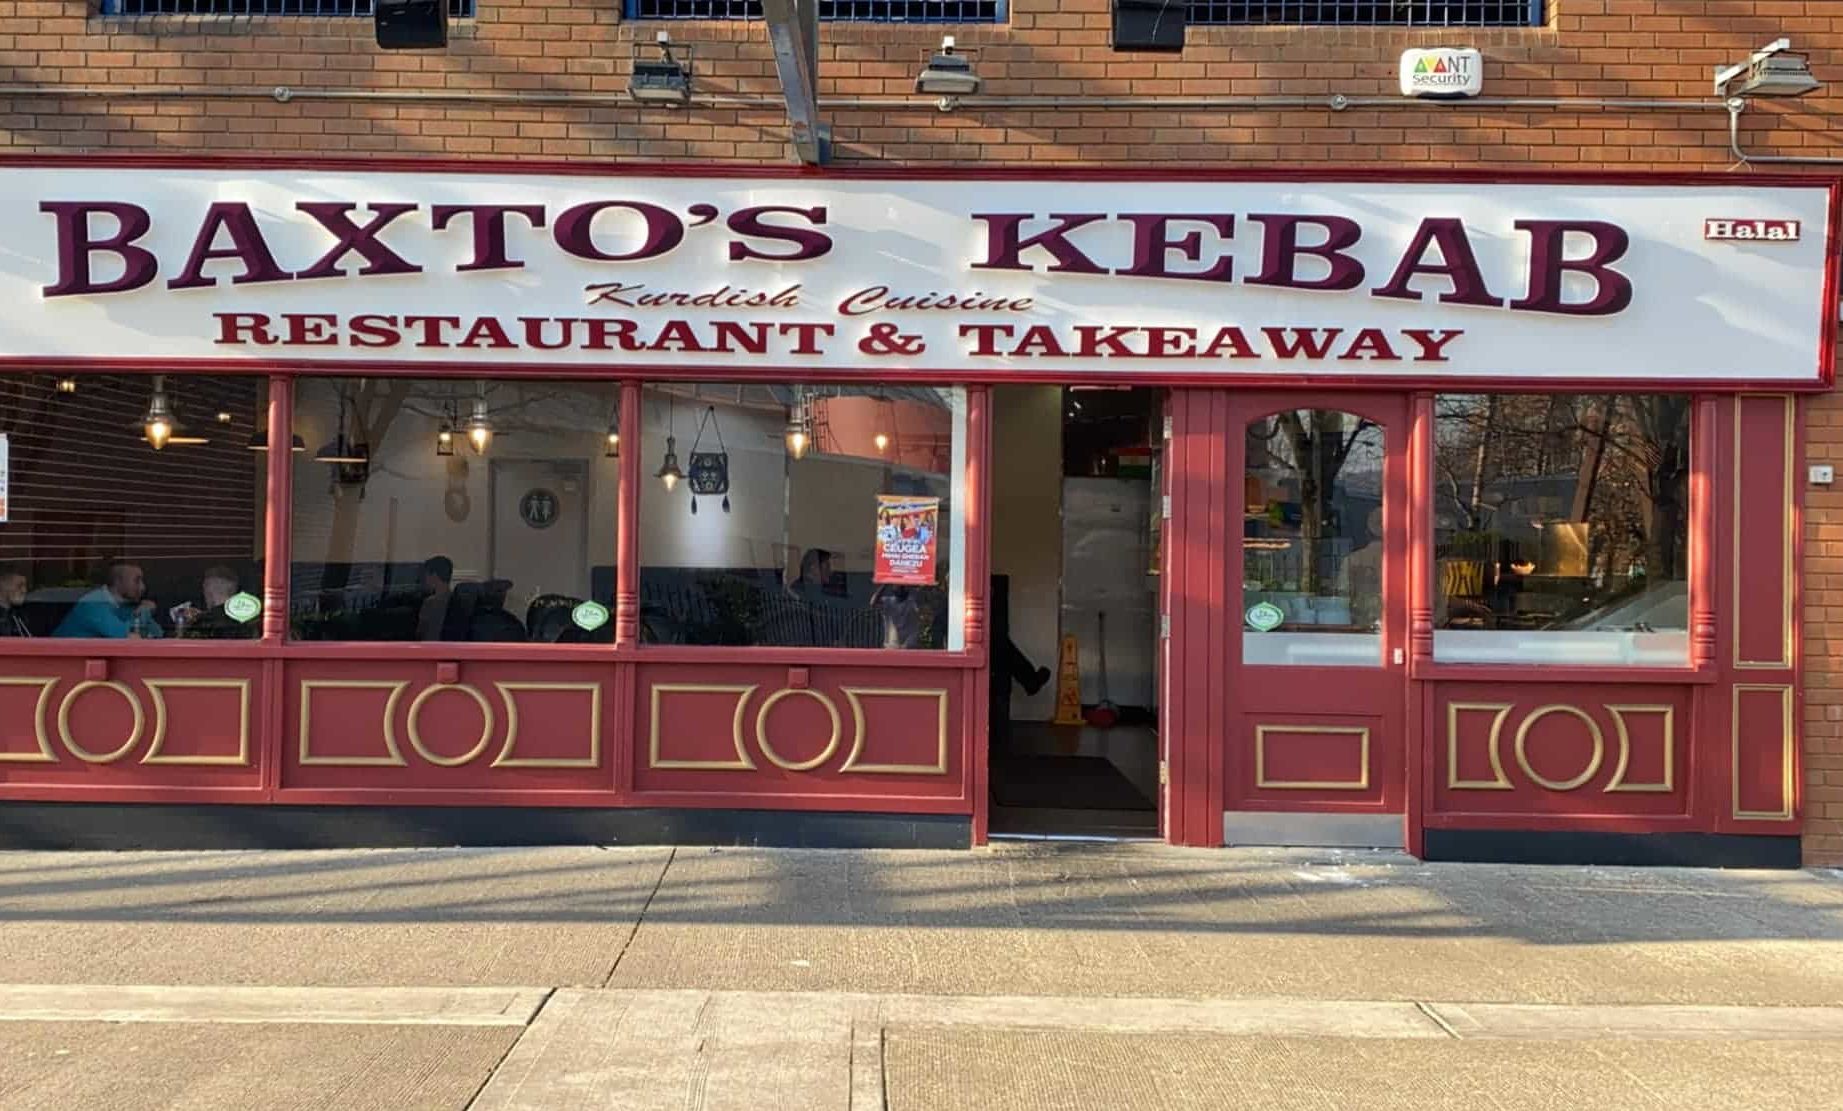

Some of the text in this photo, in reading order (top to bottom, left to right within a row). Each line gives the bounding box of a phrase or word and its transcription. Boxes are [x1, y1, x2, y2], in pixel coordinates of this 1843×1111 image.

[1412, 74, 1470, 86] Security
[1706, 220, 1798, 240] Halal
[40, 199, 1634, 315] BAXTO'S KEBAB
[585, 282, 1034, 316] Kurdish Cuisine
[214, 313, 1465, 361] RESTAURANT & TAKEAWAY
